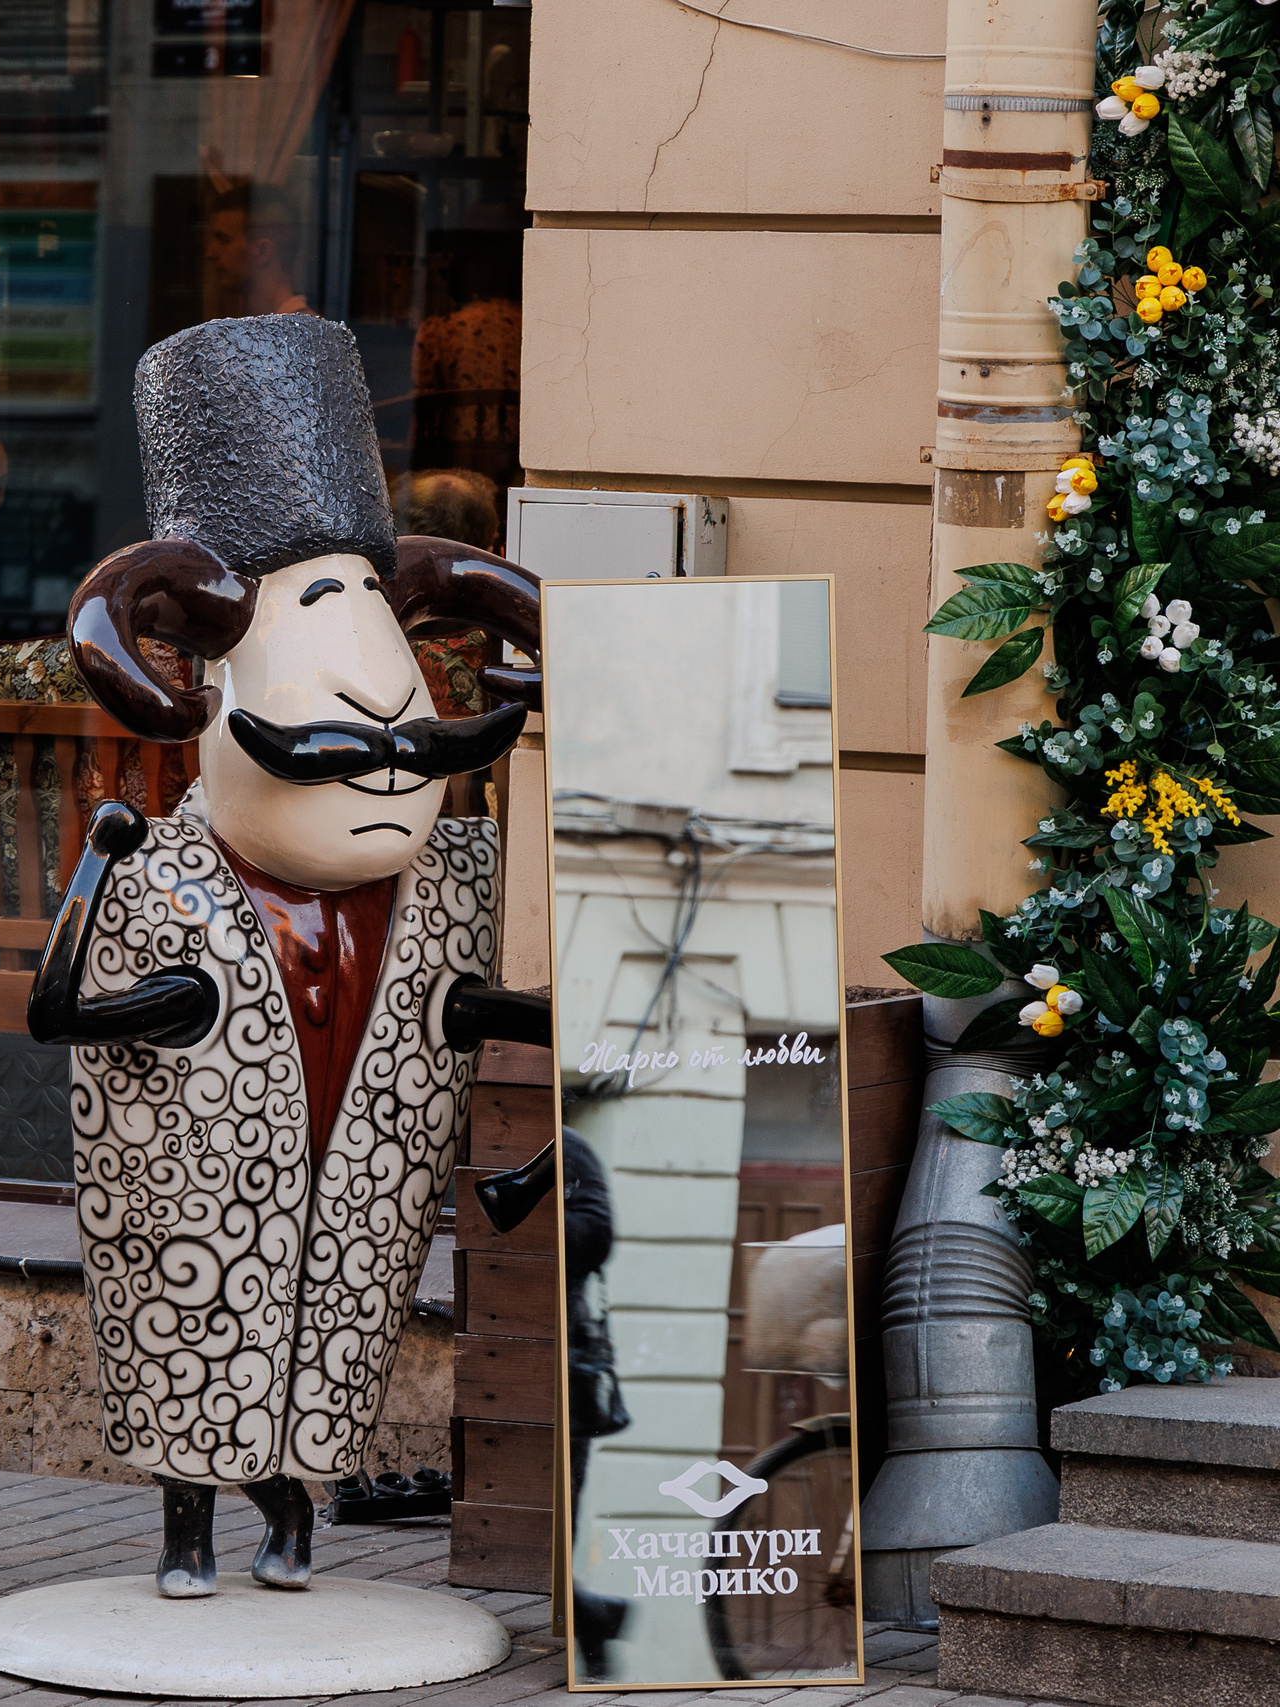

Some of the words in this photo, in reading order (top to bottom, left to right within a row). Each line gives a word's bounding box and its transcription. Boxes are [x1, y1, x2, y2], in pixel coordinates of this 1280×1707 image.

[578, 1039, 680, 1088] Жарко
[689, 1046, 731, 1069] от
[736, 1031, 826, 1067] любви
[607, 1528, 822, 1567] Хачапури
[632, 1565, 799, 1605] Марико
